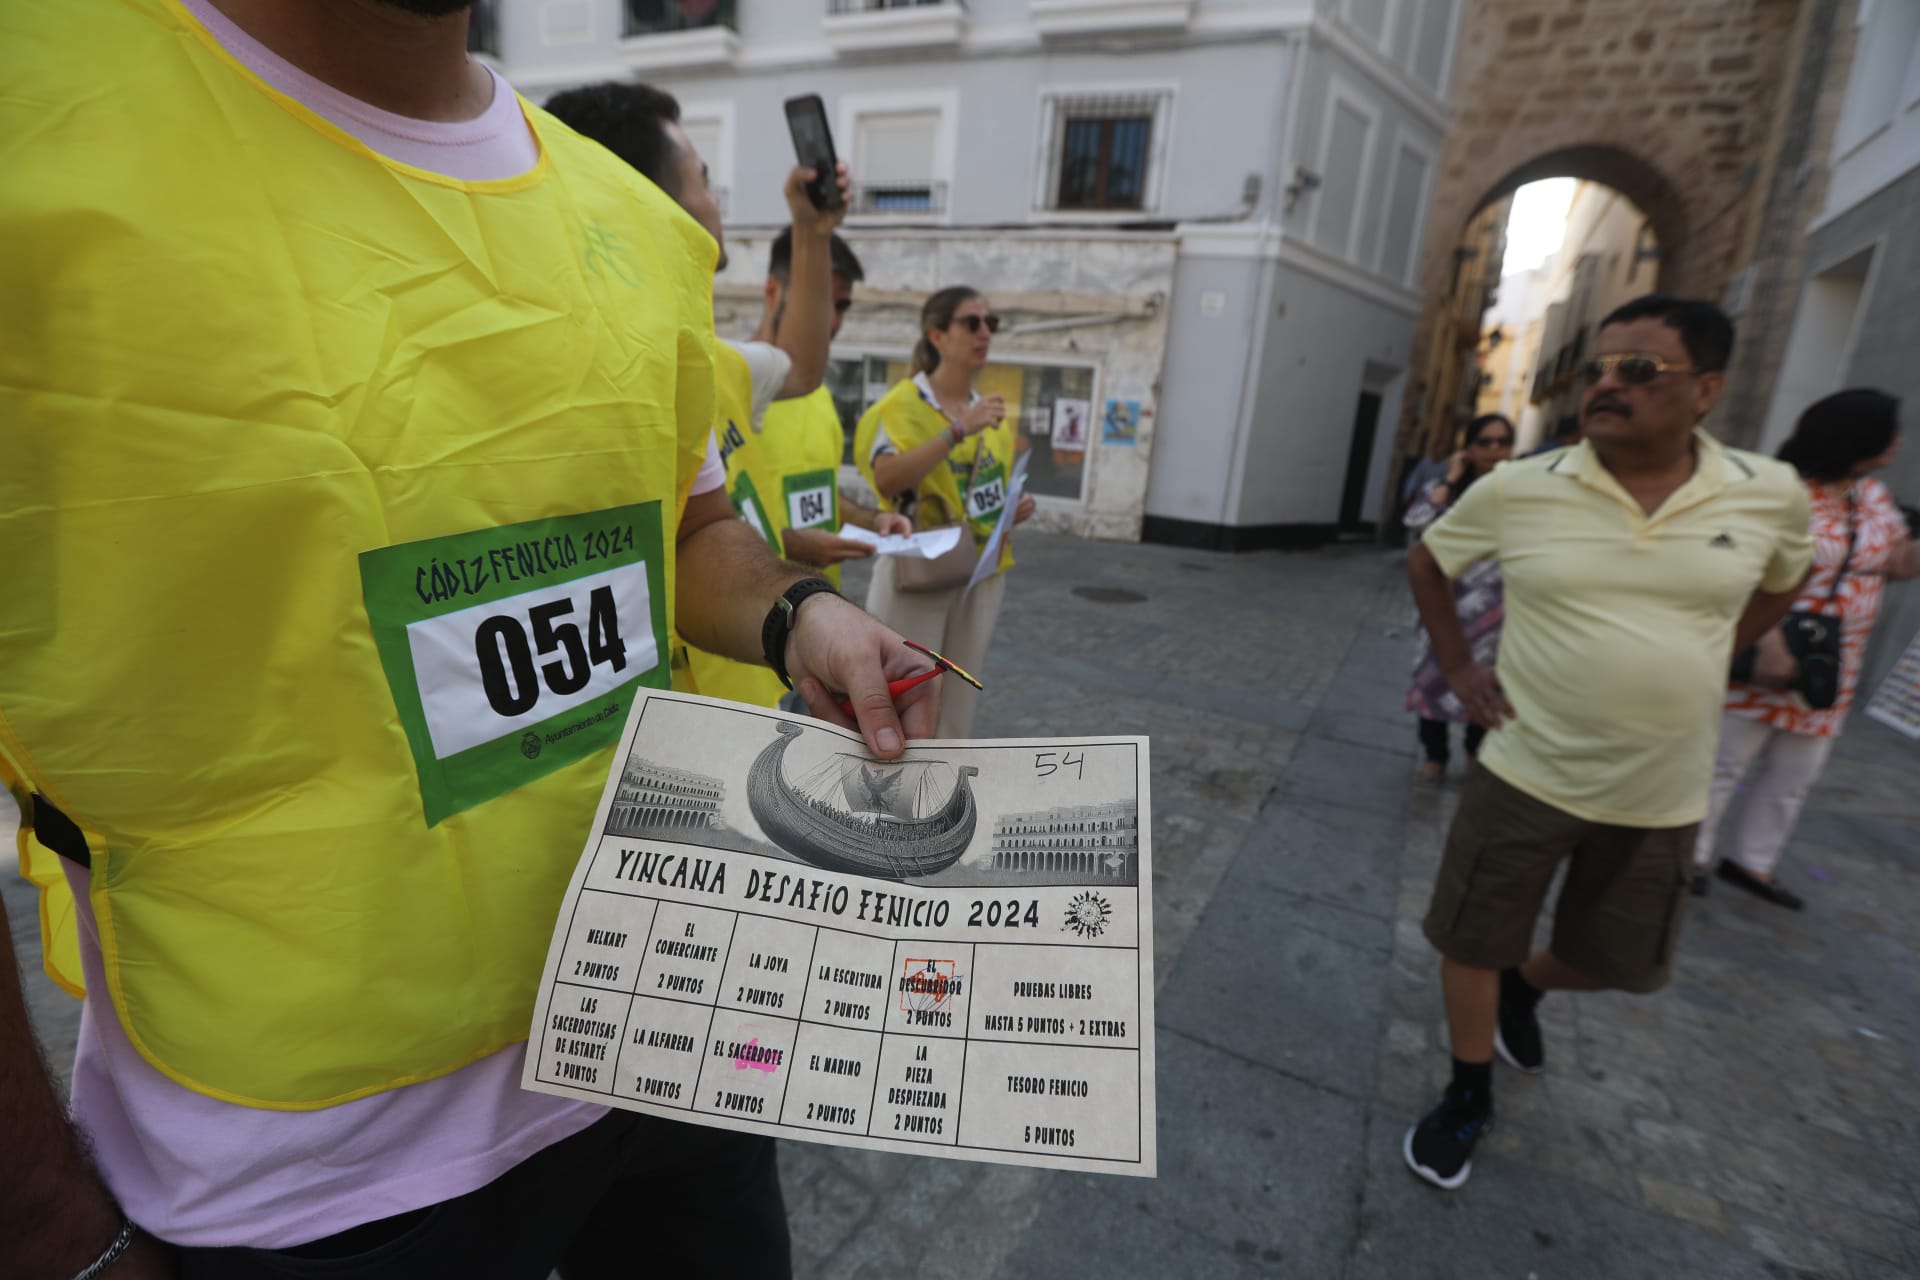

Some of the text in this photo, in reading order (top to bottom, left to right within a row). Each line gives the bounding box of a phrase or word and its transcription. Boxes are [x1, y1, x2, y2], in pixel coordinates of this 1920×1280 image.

[799, 492, 824, 523] 054
[583, 525, 634, 561] 2024
[475, 585, 627, 717] 054
[545, 716, 594, 745] Ayuntamiento
[1035, 751, 1084, 780] 54
[615, 849, 726, 894] YINCANA
[856, 889, 950, 928] FENICIO
[967, 900, 1039, 928] 2024
[684, 922, 695, 938] EL
[655, 939, 718, 962] COMERCIANTE
[574, 960, 620, 981] 2 PUNTOS
[749, 953, 789, 973] LA JOYA
[926, 959, 937, 973] EL
[658, 973, 704, 994] 2 PUNTOS
[819, 966, 883, 990] LA ESCRITURA
[899, 977, 962, 996] DESCUBRIDOR
[737, 987, 785, 1008] 2 PUNTOS
[1014, 981, 1092, 1000] PRUEBAS LIBRES
[580, 997, 598, 1014] LAS
[824, 1000, 871, 1021] 2 PUNTOS
[552, 1015, 617, 1040] SACERDOTISAS
[906, 1010, 952, 1028] 2 PUNTOS
[985, 1015, 1014, 1032] HASTA
[1017, 1016, 1024, 1033] 5
[1027, 1017, 1065, 1034] PUNTOS
[1079, 1020, 1086, 1036] 2
[1089, 1020, 1126, 1038] EXTRAS
[555, 1037, 608, 1061] DE ASTARTÉ
[633, 1028, 694, 1053] LA ALFARERA
[714, 1040, 784, 1066] EL SACERDOTE
[810, 1055, 820, 1071] EL
[916, 1046, 927, 1061] LA
[555, 1061, 598, 1084] 2 PUNTOS
[905, 1067, 933, 1084] PIEZA
[636, 1077, 682, 1100] 2 PUNTOS
[1007, 1076, 1088, 1097] TESORO FENICIO
[715, 1091, 764, 1114] 2 PUNTOS
[888, 1088, 947, 1109] DESPIEZADA
[807, 1103, 856, 1125] 2 PUNTOS
[894, 1114, 943, 1135] 2 PUNTOS
[1024, 1126, 1075, 1147] 5 PUNTOS
